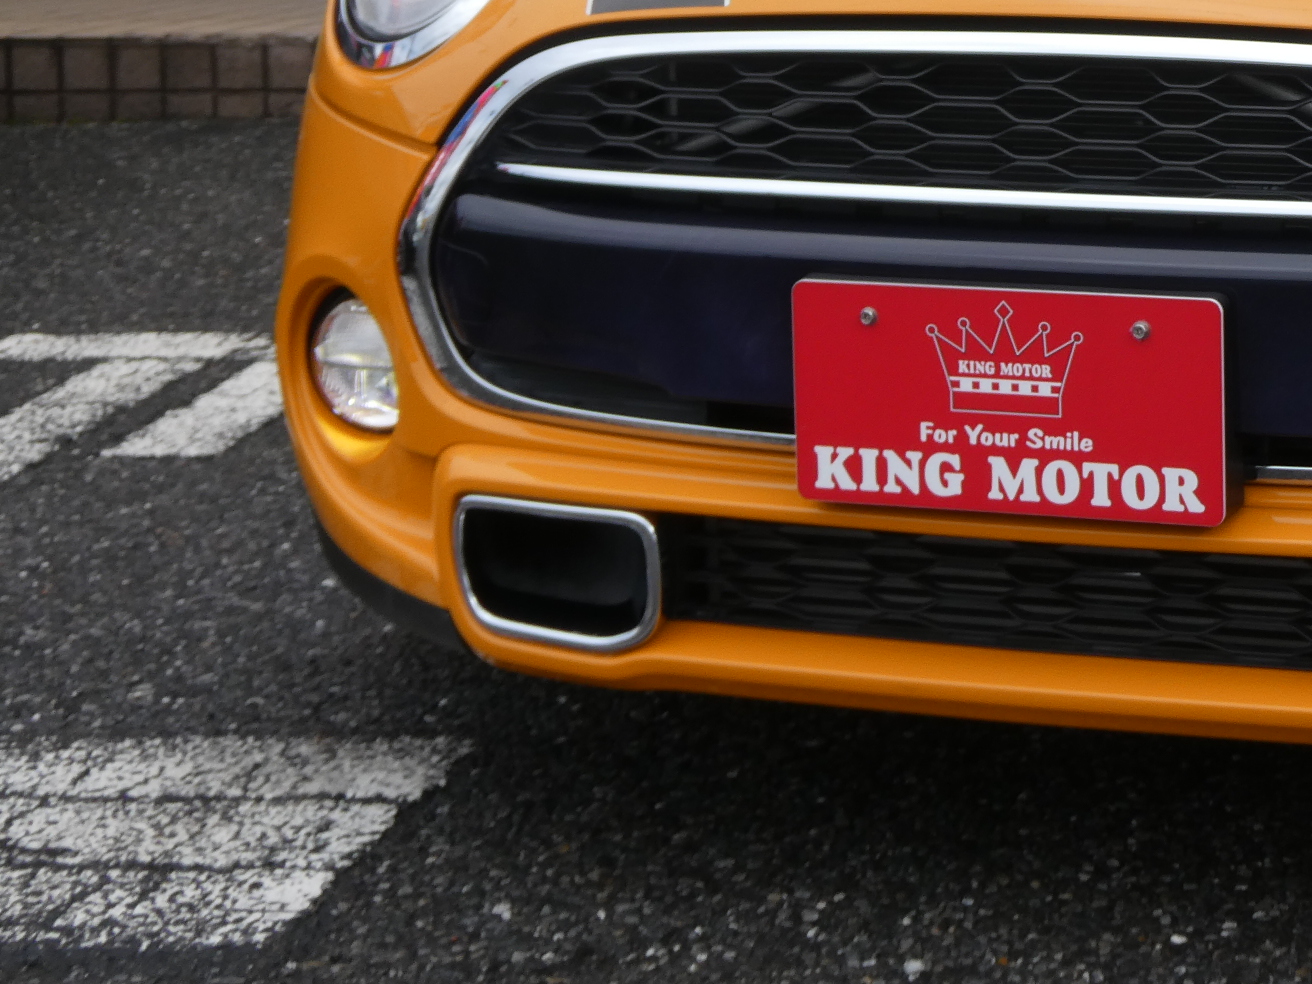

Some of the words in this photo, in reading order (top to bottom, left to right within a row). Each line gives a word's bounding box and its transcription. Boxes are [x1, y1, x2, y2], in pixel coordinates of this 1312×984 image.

[958, 360, 995, 375] KING
[1000, 362, 1052, 378] MOTOR
[919, 421, 957, 444] For
[964, 424, 1019, 448] Your
[1026, 427, 1093, 452] Smile
[814, 445, 965, 497] KING
[987, 455, 1205, 513] MOTOR
